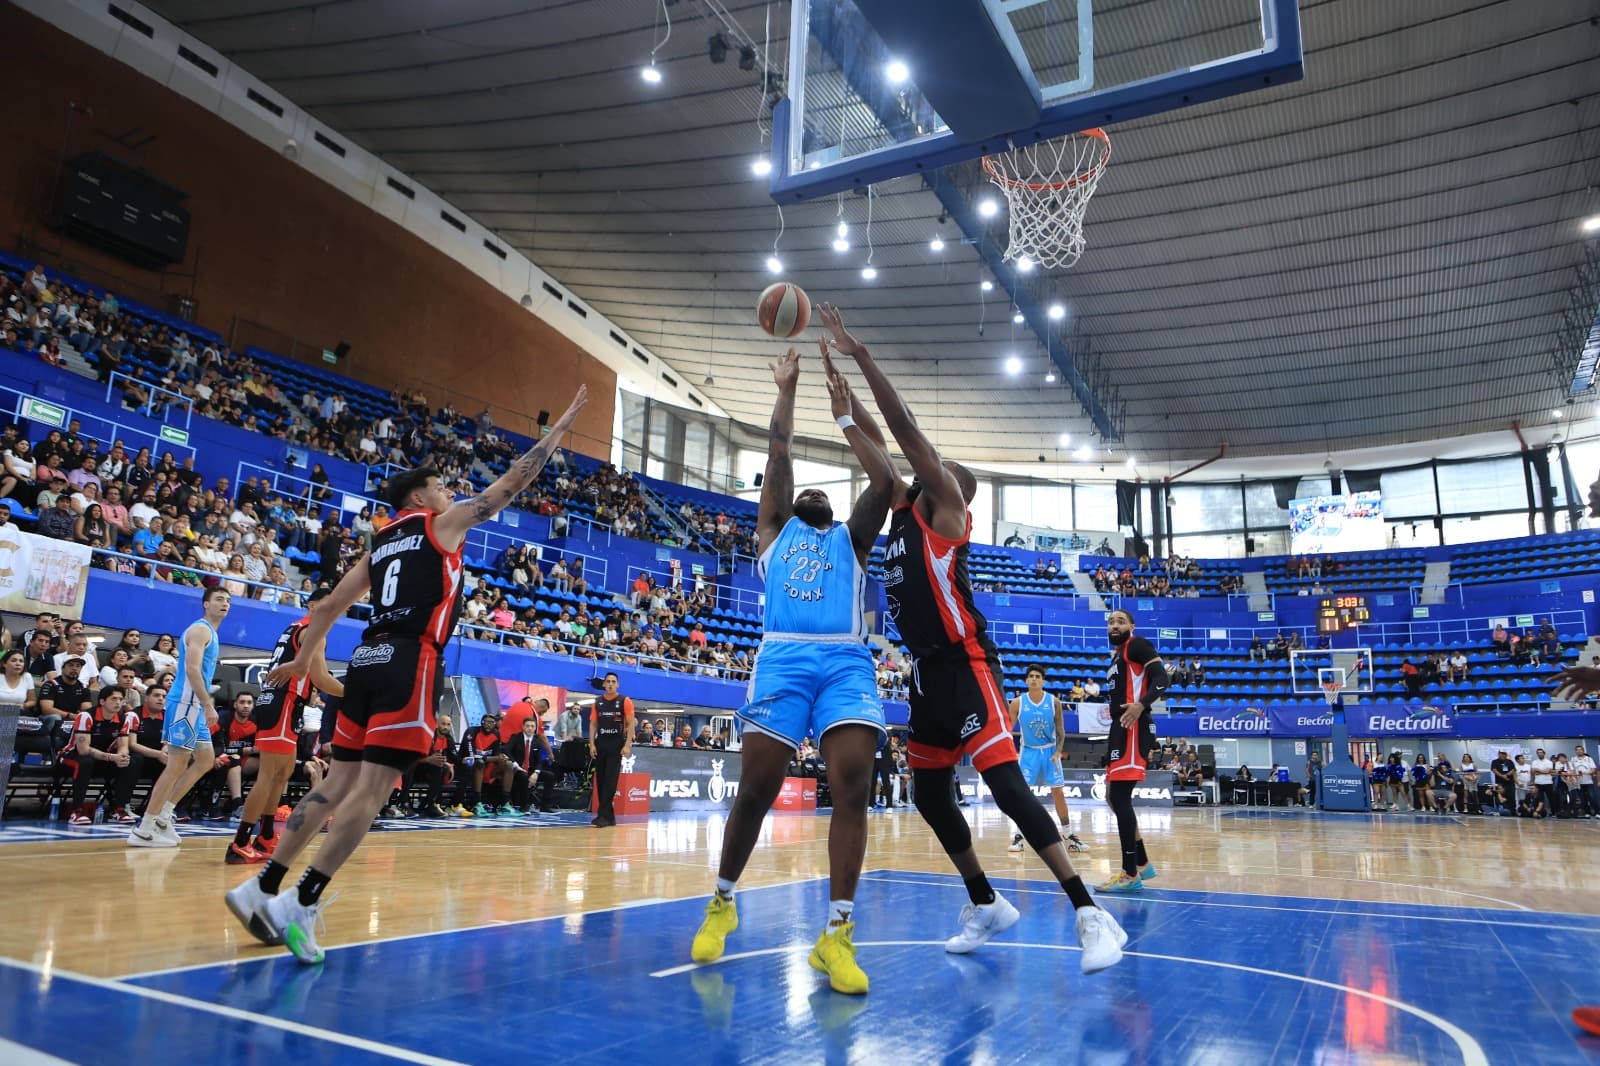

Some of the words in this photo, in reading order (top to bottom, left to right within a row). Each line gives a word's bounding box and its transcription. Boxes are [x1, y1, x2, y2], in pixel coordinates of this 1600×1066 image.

[789, 556, 822, 583] 23
[380, 558, 402, 607] 6
[783, 582, 824, 602] CDMX
[1199, 716, 1272, 731] Electrolit
[1297, 717, 1334, 726] Electrol
[1369, 714, 1451, 730] Electrolit
[649, 779, 700, 798] UFESA
[1030, 785, 1082, 798] TUFSA
